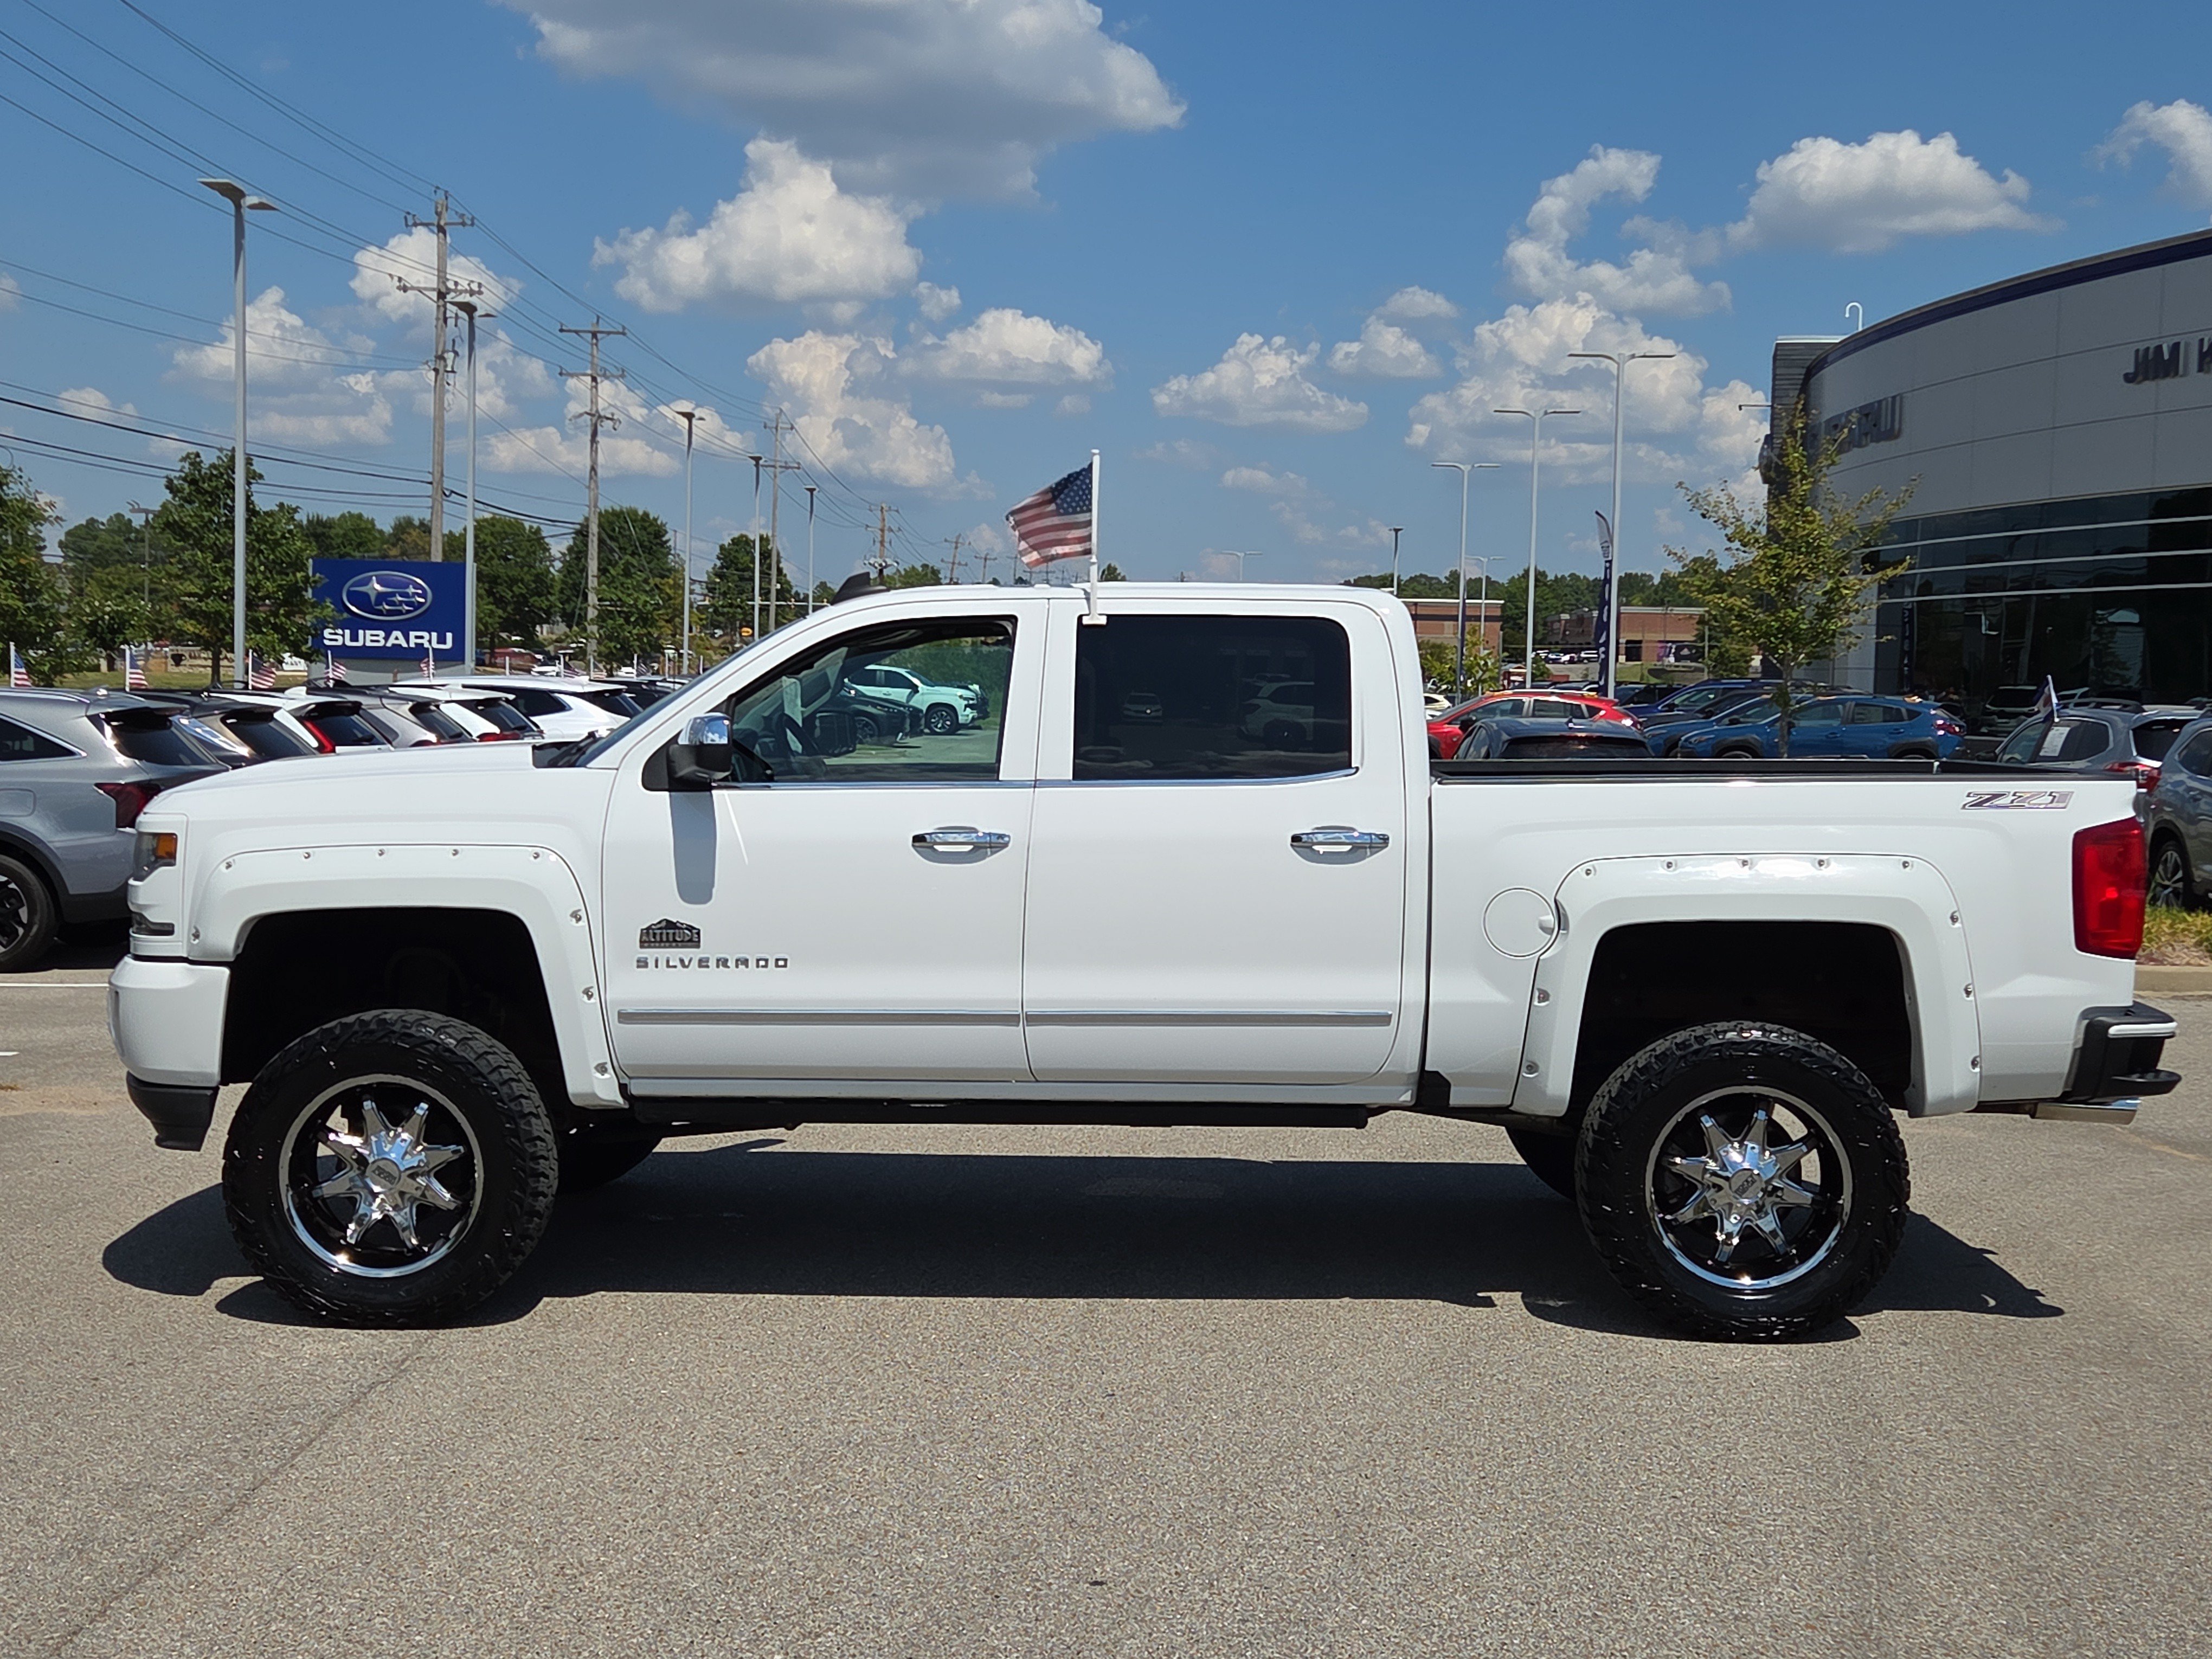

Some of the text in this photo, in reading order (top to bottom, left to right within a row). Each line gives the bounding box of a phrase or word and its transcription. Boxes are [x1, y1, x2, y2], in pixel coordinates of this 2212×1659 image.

[2123, 340, 2190, 384] JIM
[323, 628, 453, 650] SUBARU
[1960, 791, 2074, 810] Z71
[641, 929, 699, 942] ALTITUDE
[636, 956, 788, 969] SILVERADO
